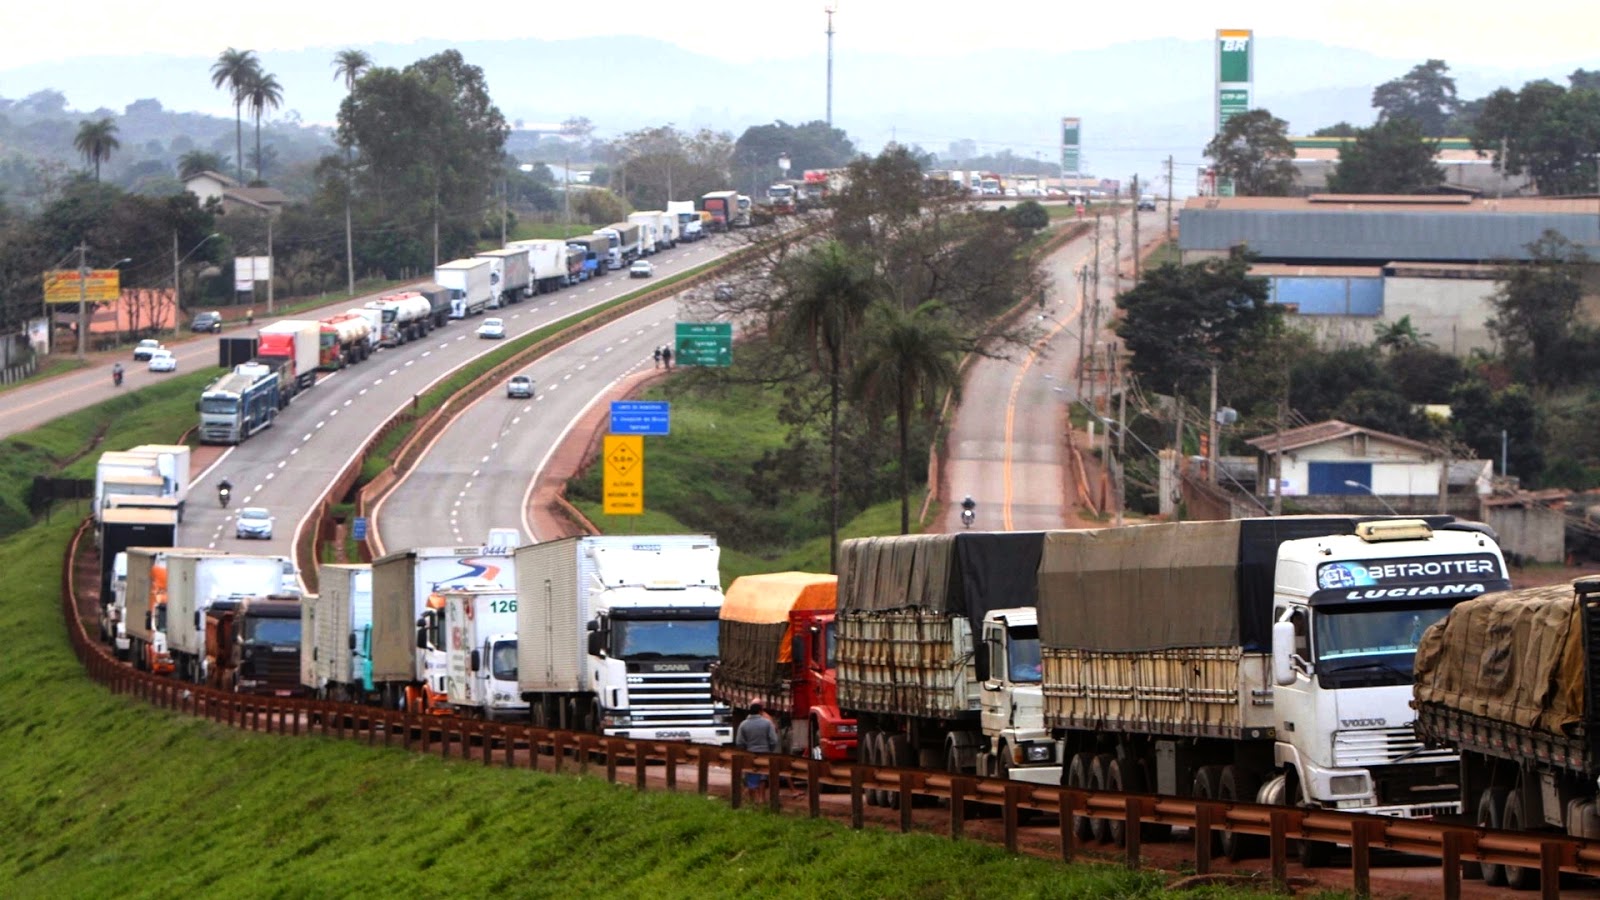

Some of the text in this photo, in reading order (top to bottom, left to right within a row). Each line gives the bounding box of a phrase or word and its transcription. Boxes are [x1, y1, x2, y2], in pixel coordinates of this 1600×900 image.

[1222, 39, 1247, 52] BR
[1323, 560, 1494, 582] GLOBETROTTER
[1346, 583, 1485, 600] LUCIANA
[653, 664, 691, 672] SCANIA
[1341, 718, 1387, 728] VOLVO
